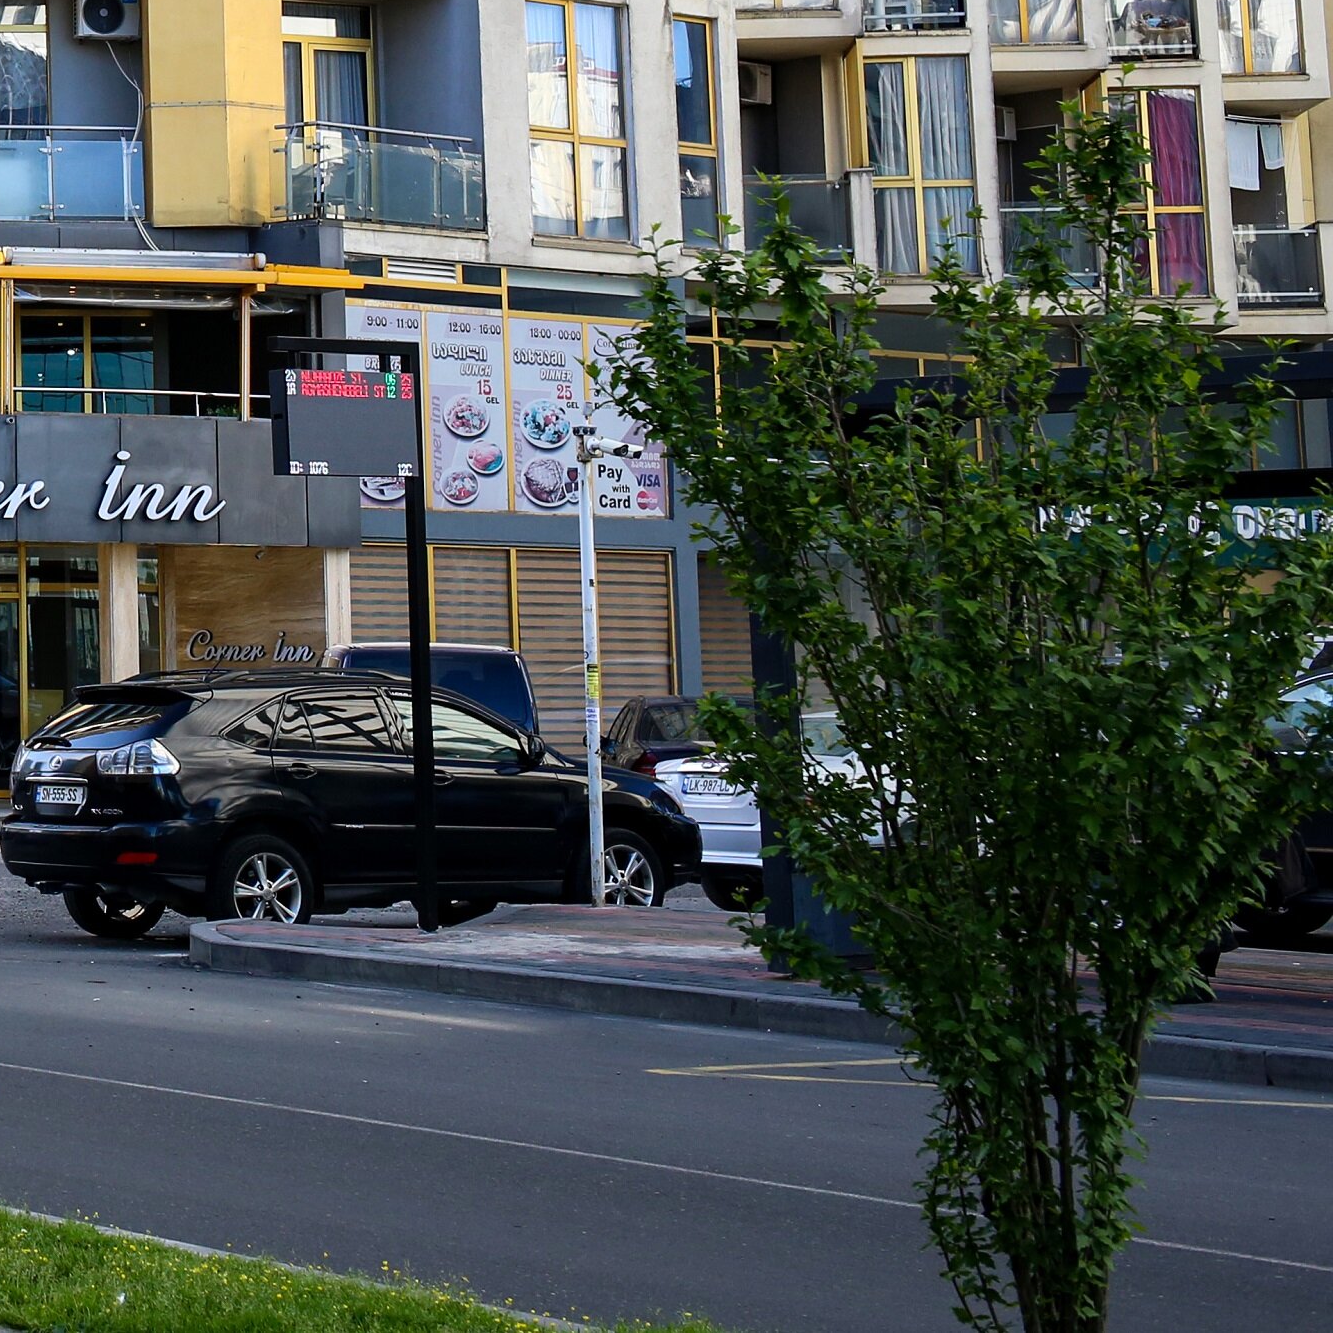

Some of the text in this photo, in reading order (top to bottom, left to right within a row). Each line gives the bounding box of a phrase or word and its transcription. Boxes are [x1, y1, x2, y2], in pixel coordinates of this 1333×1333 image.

[367, 316, 387, 327] 9:00
[396, 318, 419, 329] 11:00
[448, 321, 471, 333] 12:00
[479, 324, 501, 335] 16:00
[530, 327, 551, 339] 18:00
[558, 330, 581, 341] 00:00
[432, 342, 487, 361] სადილი
[513, 348, 566, 366] ვახშამი
[460, 363, 492, 377] LUNCH
[540, 369, 573, 383] DINNER
[385, 373, 397, 385] 06
[374, 385, 386, 398] ST
[386, 385, 397, 399] 12
[477, 379, 492, 396] 15
[556, 383, 573, 400] 25
[485, 396, 499, 404] GEL
[566, 401, 580, 409] GEL
[308, 461, 329, 475] 1076
[597, 464, 623, 482] Pay
[97, 450, 227, 523] inn
[635, 474, 661, 487] VISA
[612, 484, 631, 493] with
[599, 494, 631, 509] Card
[187, 630, 264, 661] Corner
[41, 786, 78, 802] SN-555-SS
